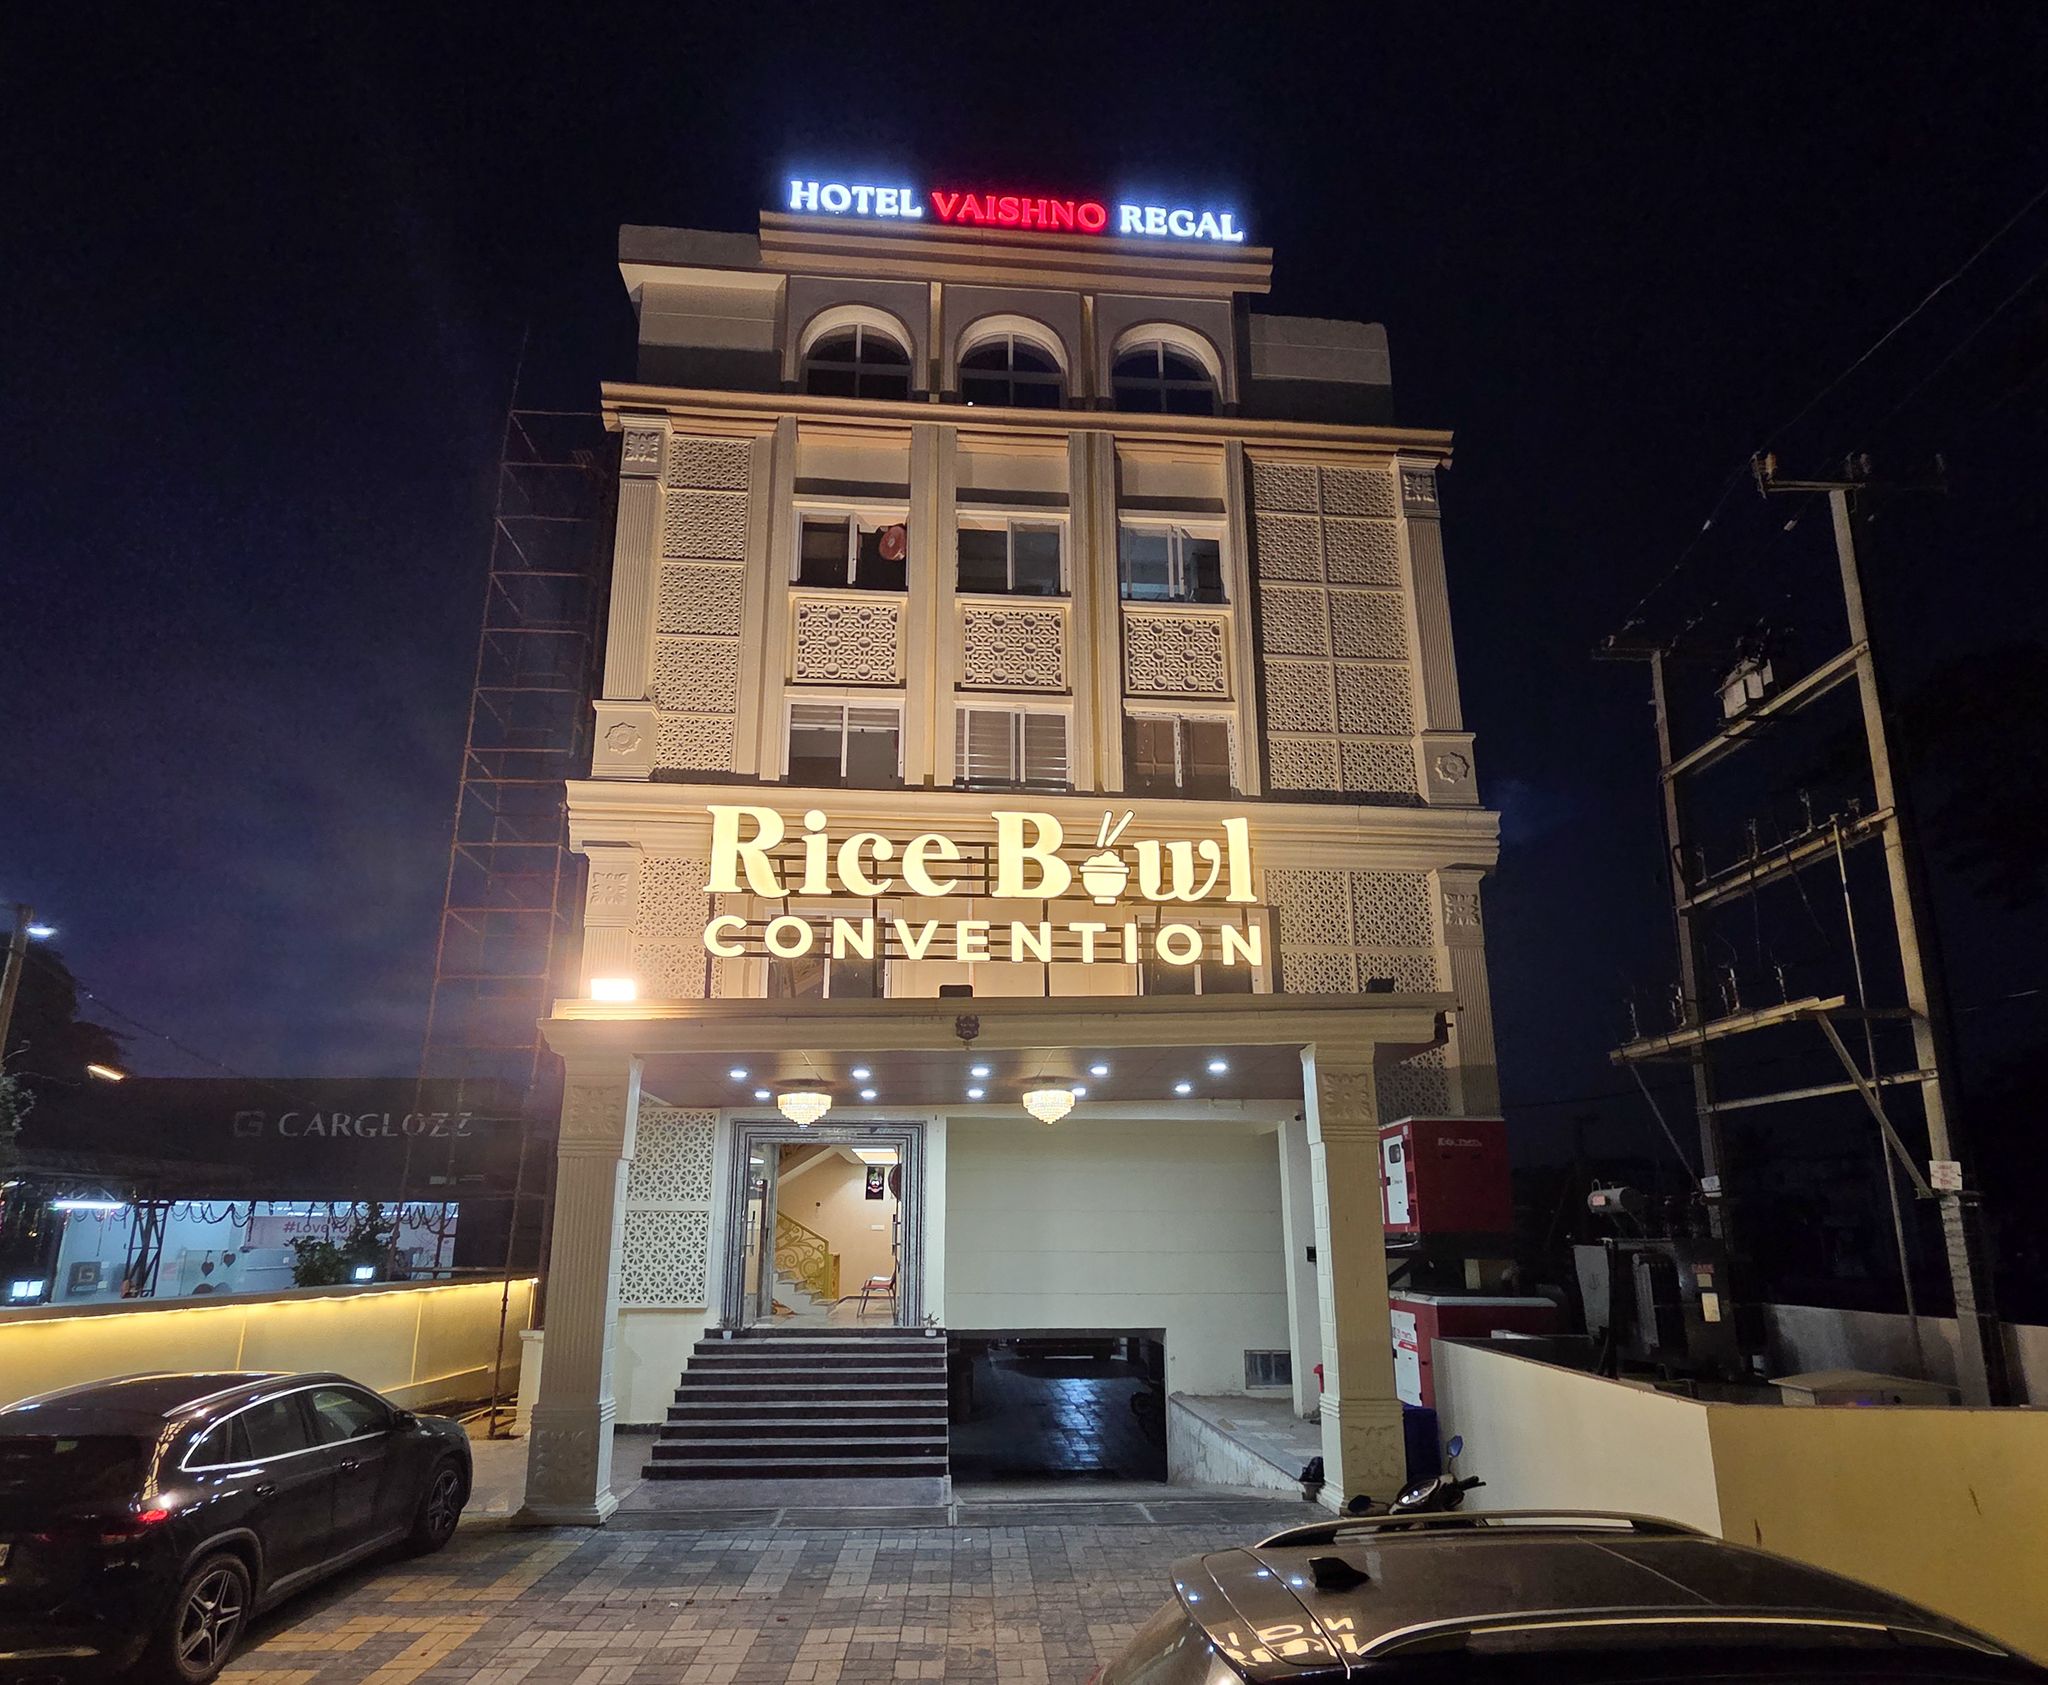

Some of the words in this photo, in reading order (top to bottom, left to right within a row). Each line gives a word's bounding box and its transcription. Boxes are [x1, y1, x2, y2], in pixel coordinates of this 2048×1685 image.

[789, 180, 922, 217] HOTEL
[932, 192, 1107, 230] VAISHNO
[1120, 204, 1243, 242] REGAL
[703, 804, 960, 898] Rice
[703, 915, 1262, 966] CONVENTION
[278, 1111, 473, 1138] CARGLOZZ
